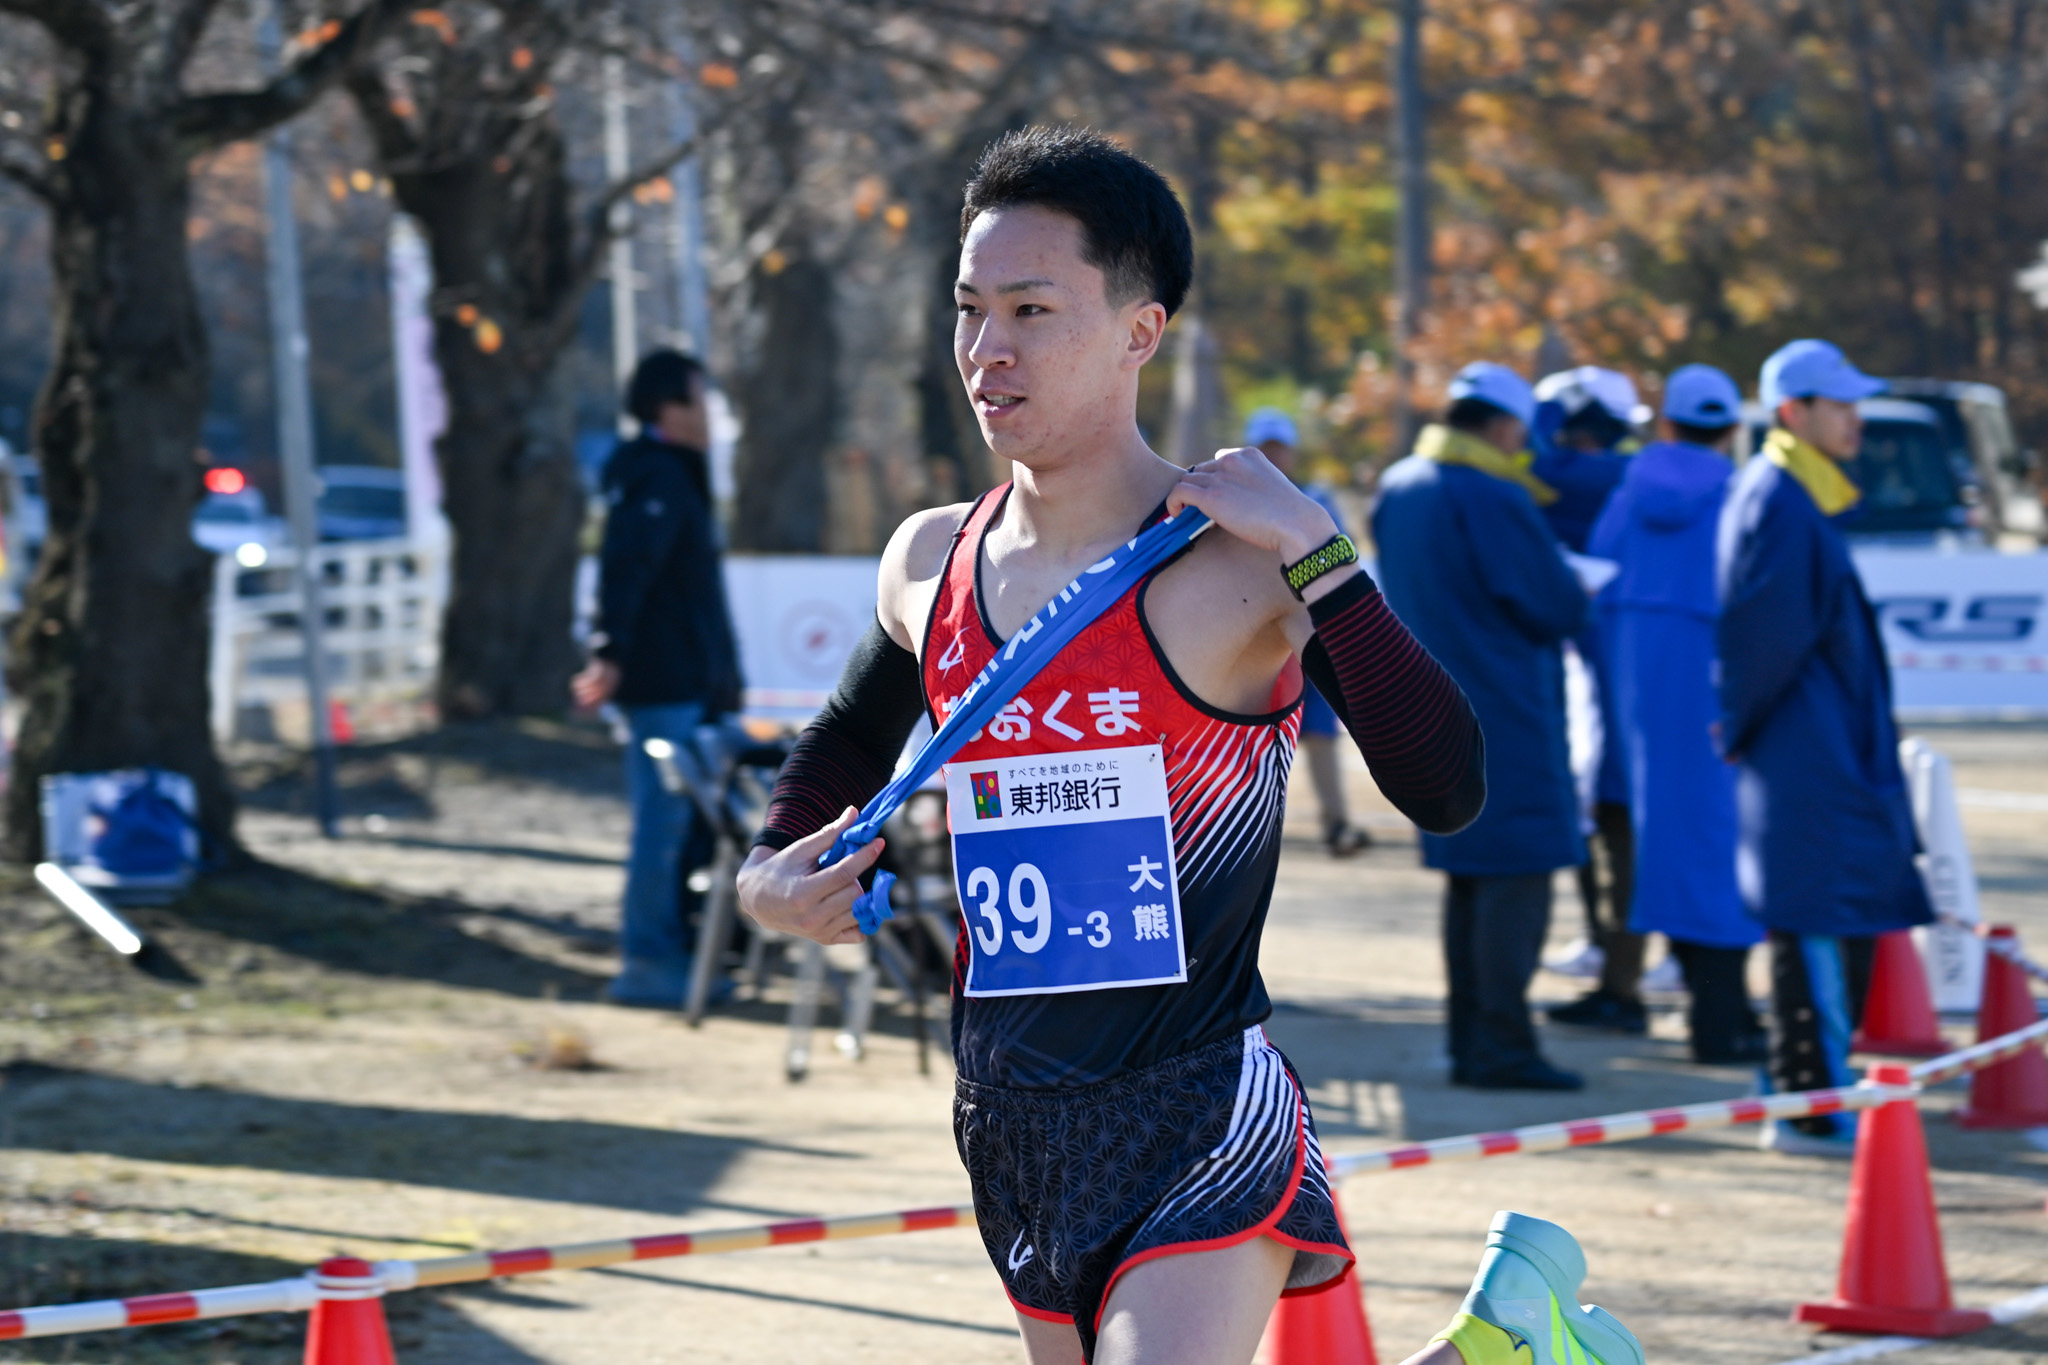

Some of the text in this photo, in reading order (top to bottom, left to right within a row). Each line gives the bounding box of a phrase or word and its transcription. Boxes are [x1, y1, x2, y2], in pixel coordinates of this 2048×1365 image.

[942, 687, 1142, 742] おくま
[1008, 760, 1119, 779] すべてを地域のために
[1009, 776, 1121, 816] 東邦銀行
[1127, 855, 1170, 942] 大熊
